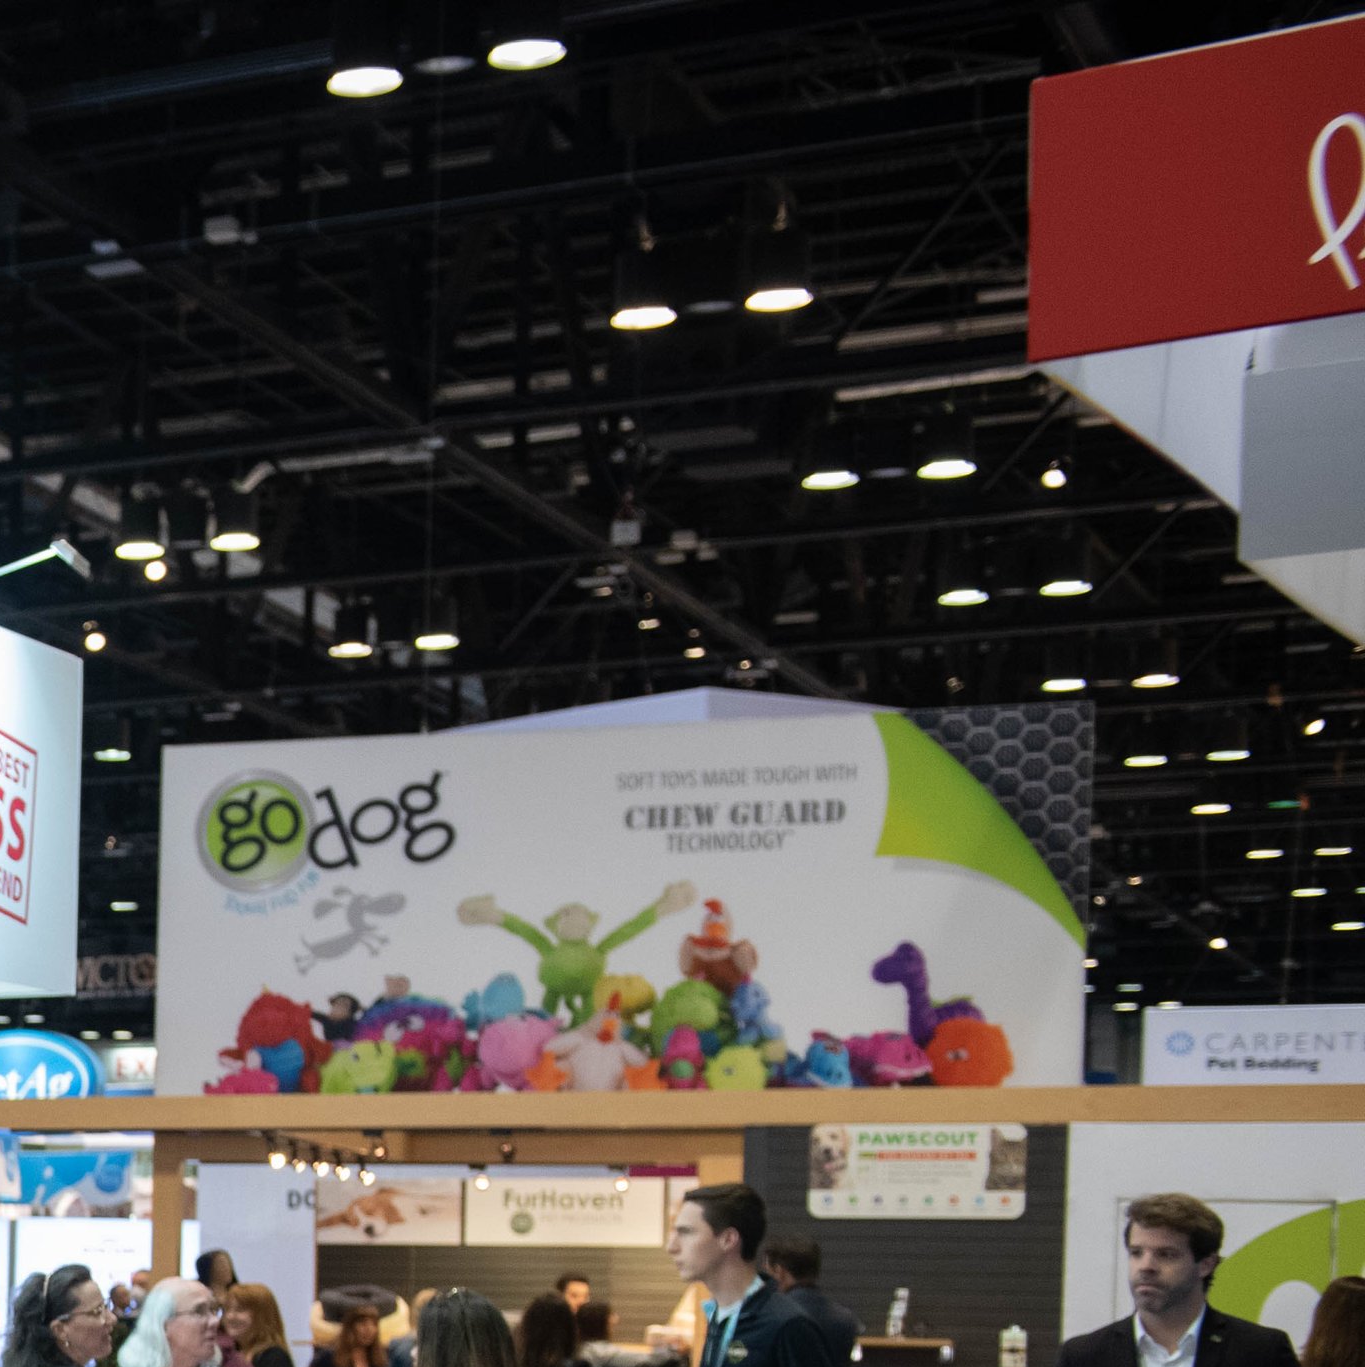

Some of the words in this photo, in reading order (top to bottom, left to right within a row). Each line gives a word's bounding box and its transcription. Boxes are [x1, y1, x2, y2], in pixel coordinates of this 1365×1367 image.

[616, 771, 654, 791] SOFT
[660, 769, 697, 790] TOYS
[701, 767, 748, 788] MADE
[752, 765, 810, 786] TOUGH
[815, 763, 858, 782] WITH
[624, 802, 719, 830] CHEW
[729, 798, 847, 826] GUARD
[1206, 1056, 1237, 1069] Pet
[1243, 1056, 1320, 1074] Bedding
[857, 1130, 979, 1146] PAWSCOUT
[503, 1186, 625, 1212] FurHaven
